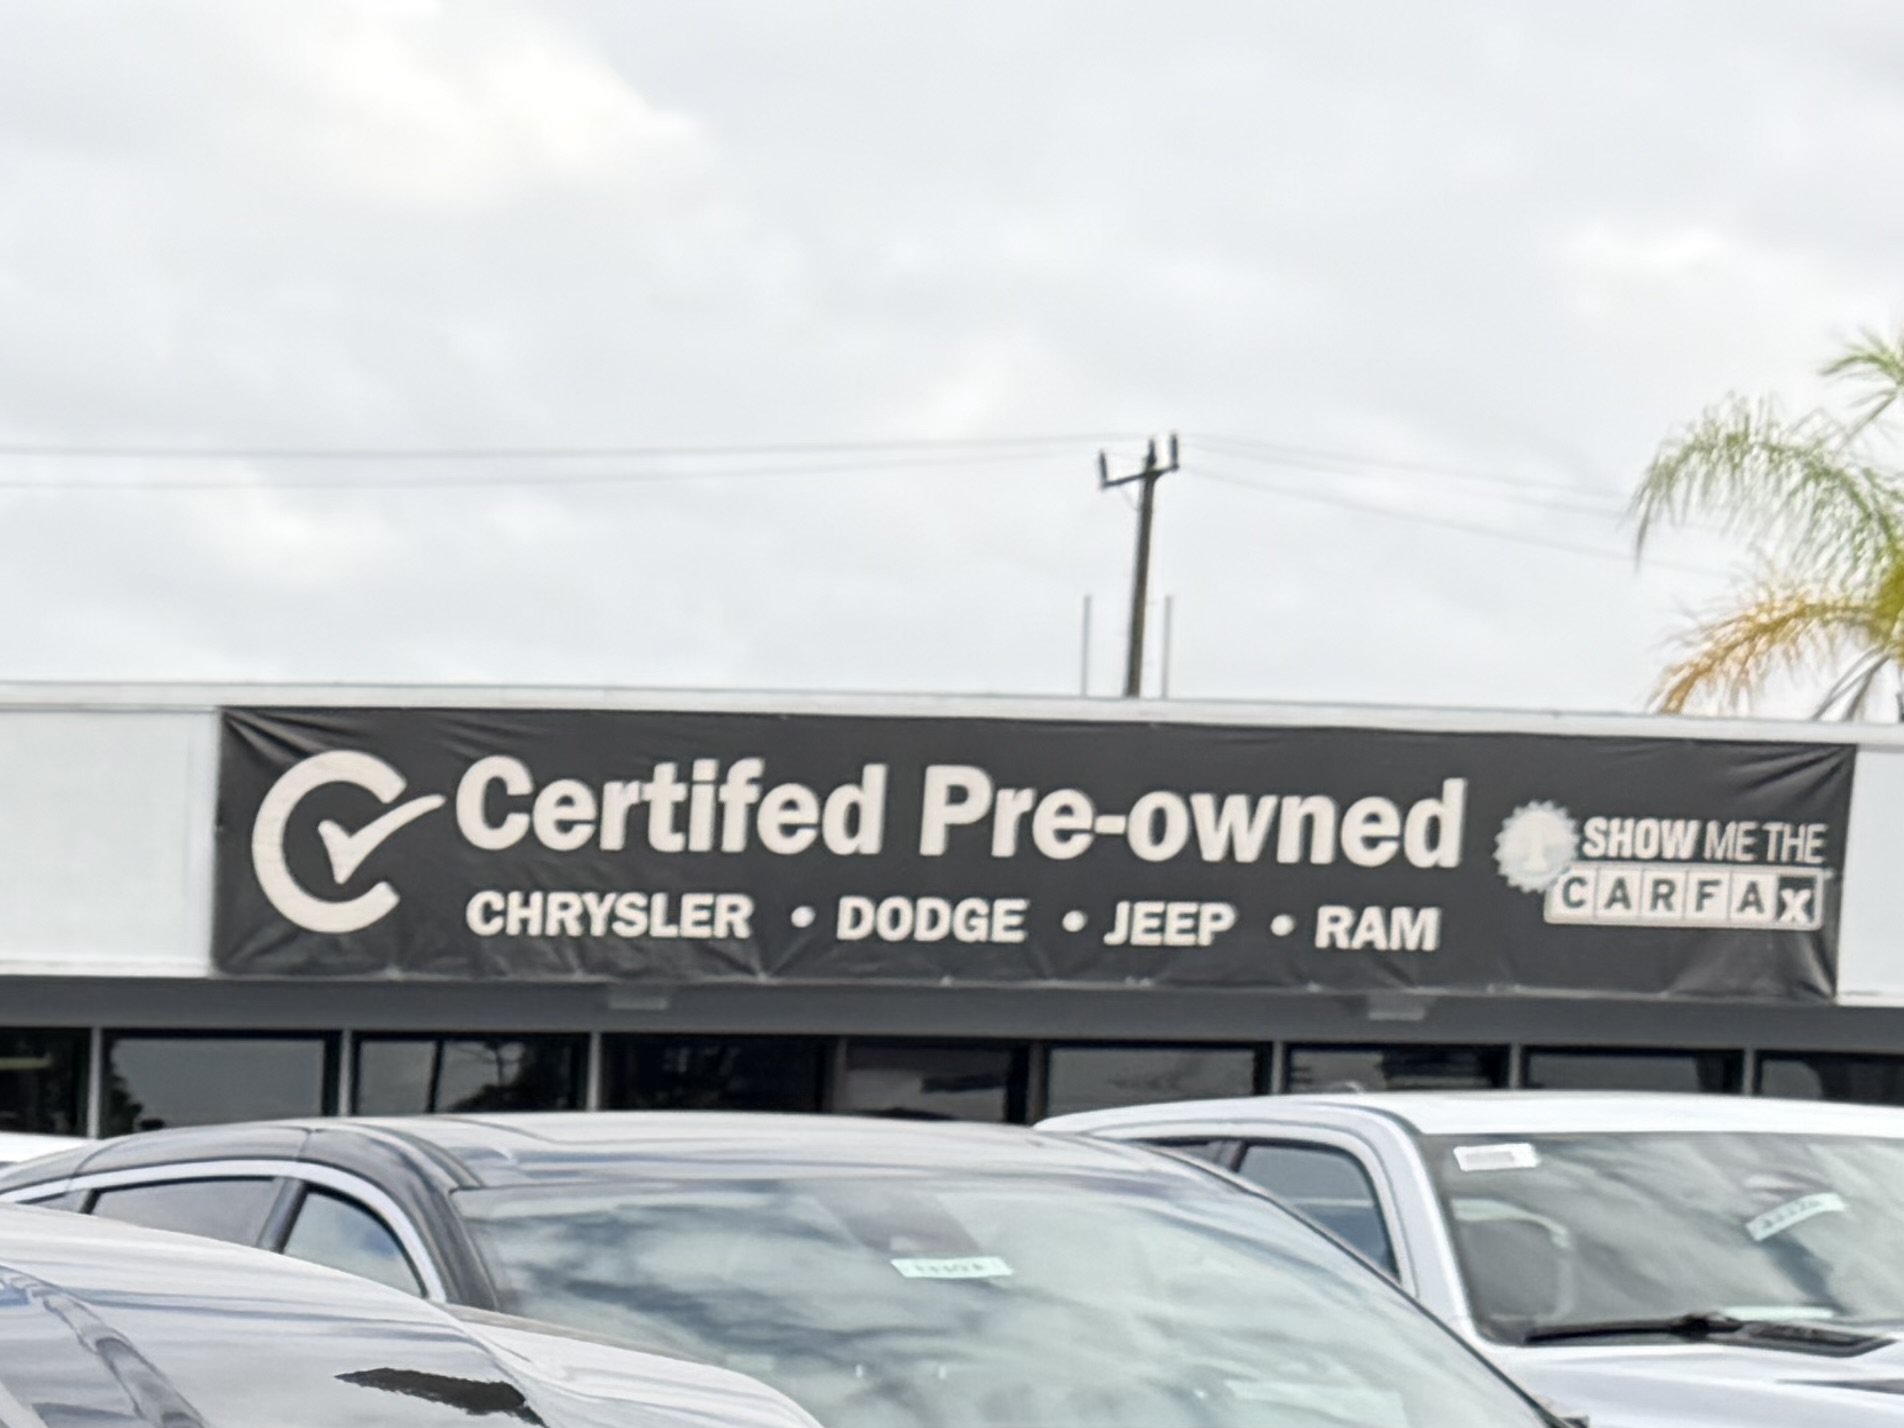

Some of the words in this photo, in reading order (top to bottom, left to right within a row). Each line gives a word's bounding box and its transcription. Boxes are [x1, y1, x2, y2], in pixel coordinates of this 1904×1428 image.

[455, 755, 889, 856] Certifed
[919, 763, 1468, 868] Pre-owned
[1582, 816, 1700, 859] SHOW
[1703, 819, 1760, 862] ME
[1762, 821, 1830, 864] THE
[465, 890, 755, 939] CHRYSLER
[835, 896, 1030, 944] DODGE
[1103, 900, 1237, 947] JEEP
[1314, 905, 1442, 952] RAM
[1557, 873, 1814, 926] CARFAX
